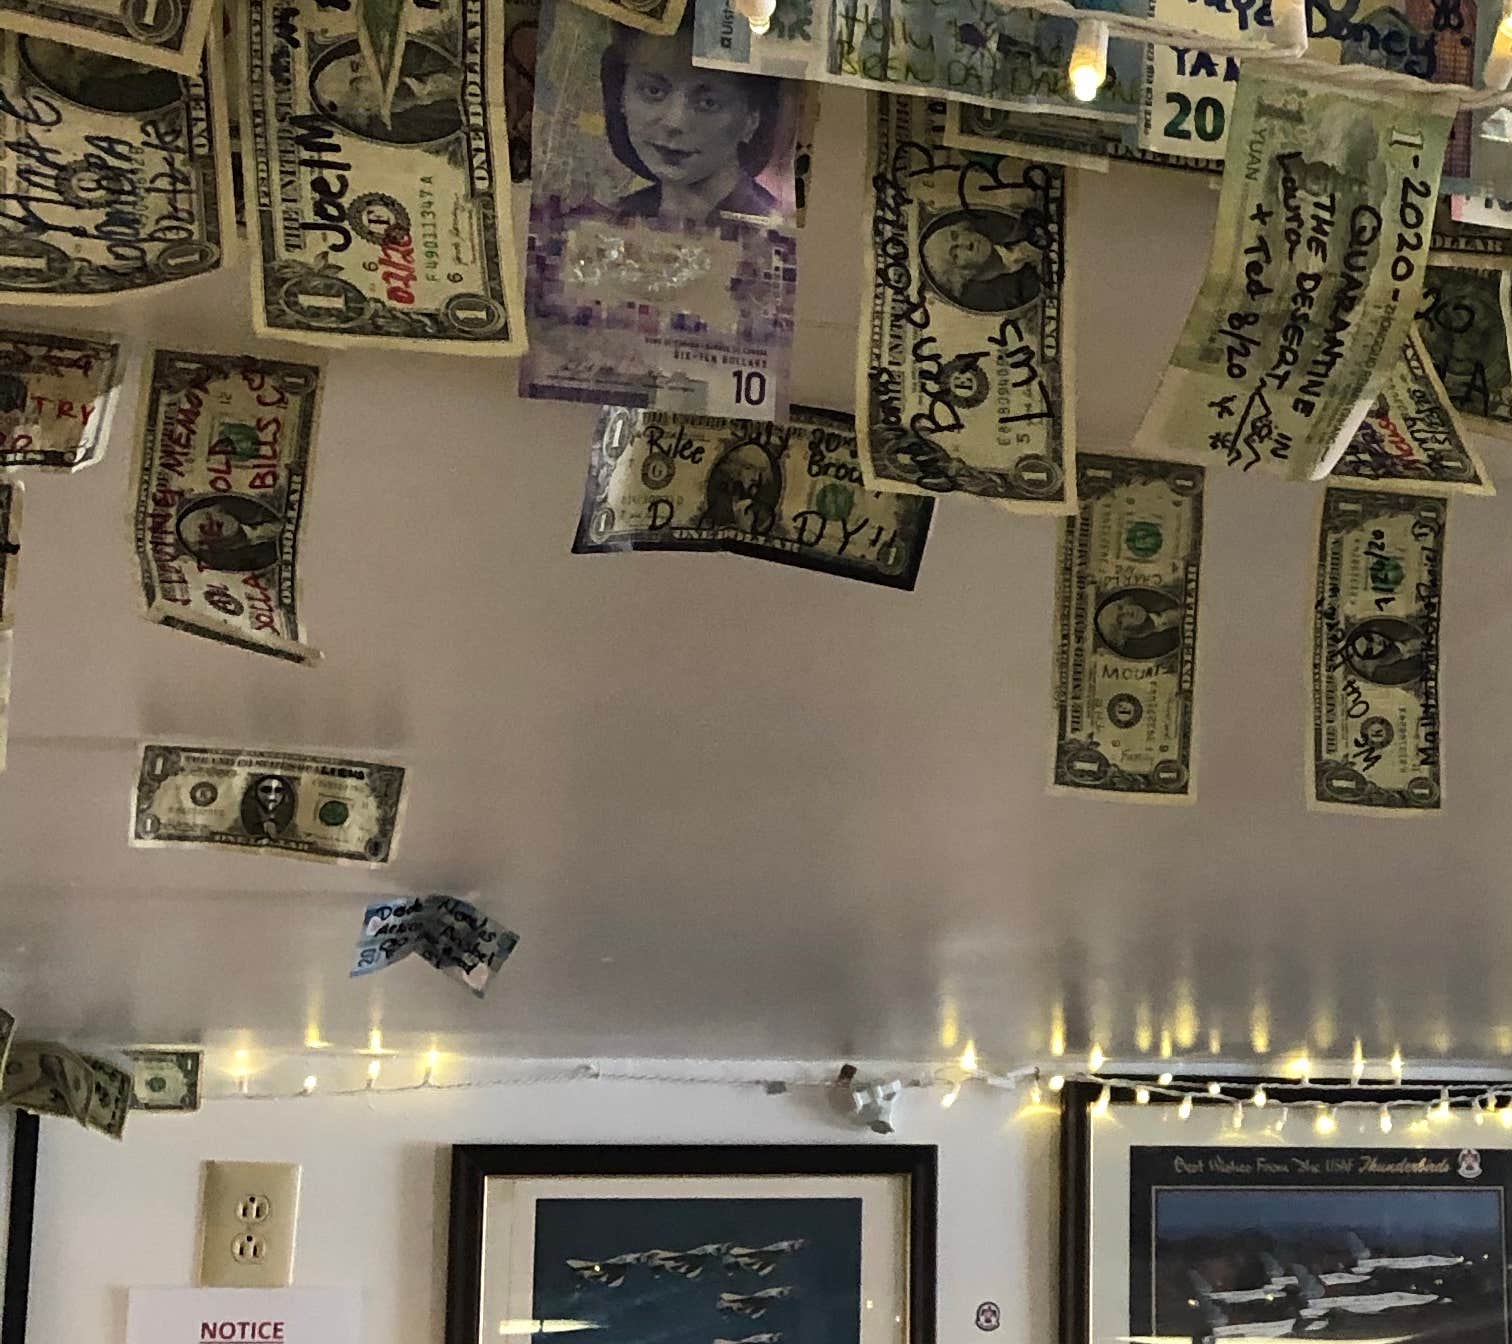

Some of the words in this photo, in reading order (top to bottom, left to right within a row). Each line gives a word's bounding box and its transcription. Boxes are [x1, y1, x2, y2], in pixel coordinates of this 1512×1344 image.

[1164, 91, 1226, 142] 20
[466, 131, 489, 189] ONE
[1246, 126, 1269, 182] YUAN
[304, 160, 352, 253] Joel
[1307, 193, 1337, 263] THE
[1243, 235, 1275, 303] Ted
[1267, 271, 1323, 391] DESERT
[1292, 205, 1383, 419] QUARANTINE
[1219, 310, 1263, 381] 8/20
[732, 369, 767, 407] 10
[209, 435, 232, 494] OLD
[250, 416, 282, 490] BILLS
[1358, 1155, 1450, 1173] Thunderbirds
[201, 1322, 284, 1341] NOTICE
